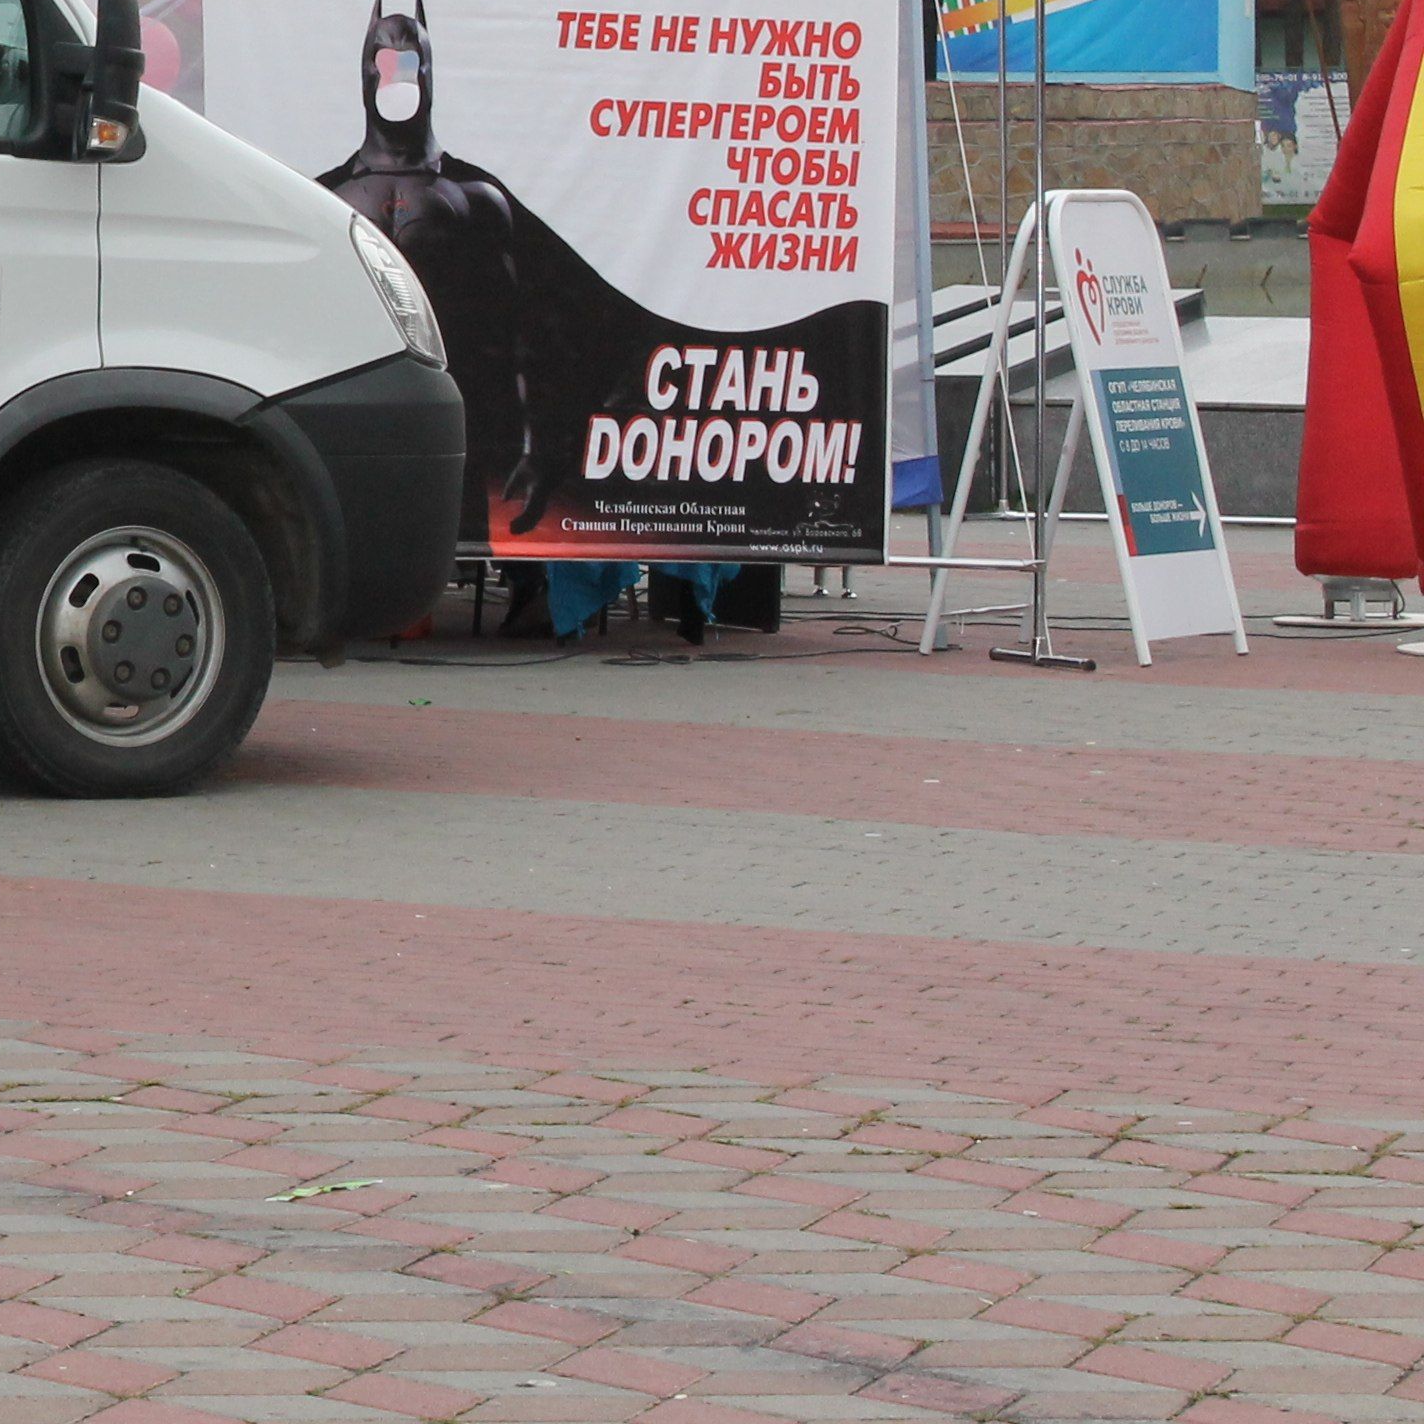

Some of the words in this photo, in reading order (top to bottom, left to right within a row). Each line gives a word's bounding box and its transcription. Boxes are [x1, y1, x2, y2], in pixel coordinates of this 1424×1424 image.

[556, 11, 642, 51] ТЕБЕ
[651, 15, 700, 53] НЕ
[708, 17, 863, 60] НУЖНО
[758, 62, 861, 101] БЫТЬ
[589, 98, 861, 144] СУПЕРГЕРОЕМ
[726, 147, 861, 187] ЧТОБЫ
[688, 188, 859, 229] СПАСАТЬ
[705, 232, 859, 272] ЖИЗНИ
[1102, 275, 1148, 294] СЛУЖБА
[1106, 297, 1144, 315] КРОВИ
[646, 343, 819, 412] СТАНЬ
[561, 517, 616, 532] Станция
[620, 518, 702, 535] Переливания
[706, 520, 745, 536] Крови
[595, 500, 676, 515] Челябинская
[679, 502, 745, 516] Областная
[749, 540, 823, 555] www.ospk.ru
